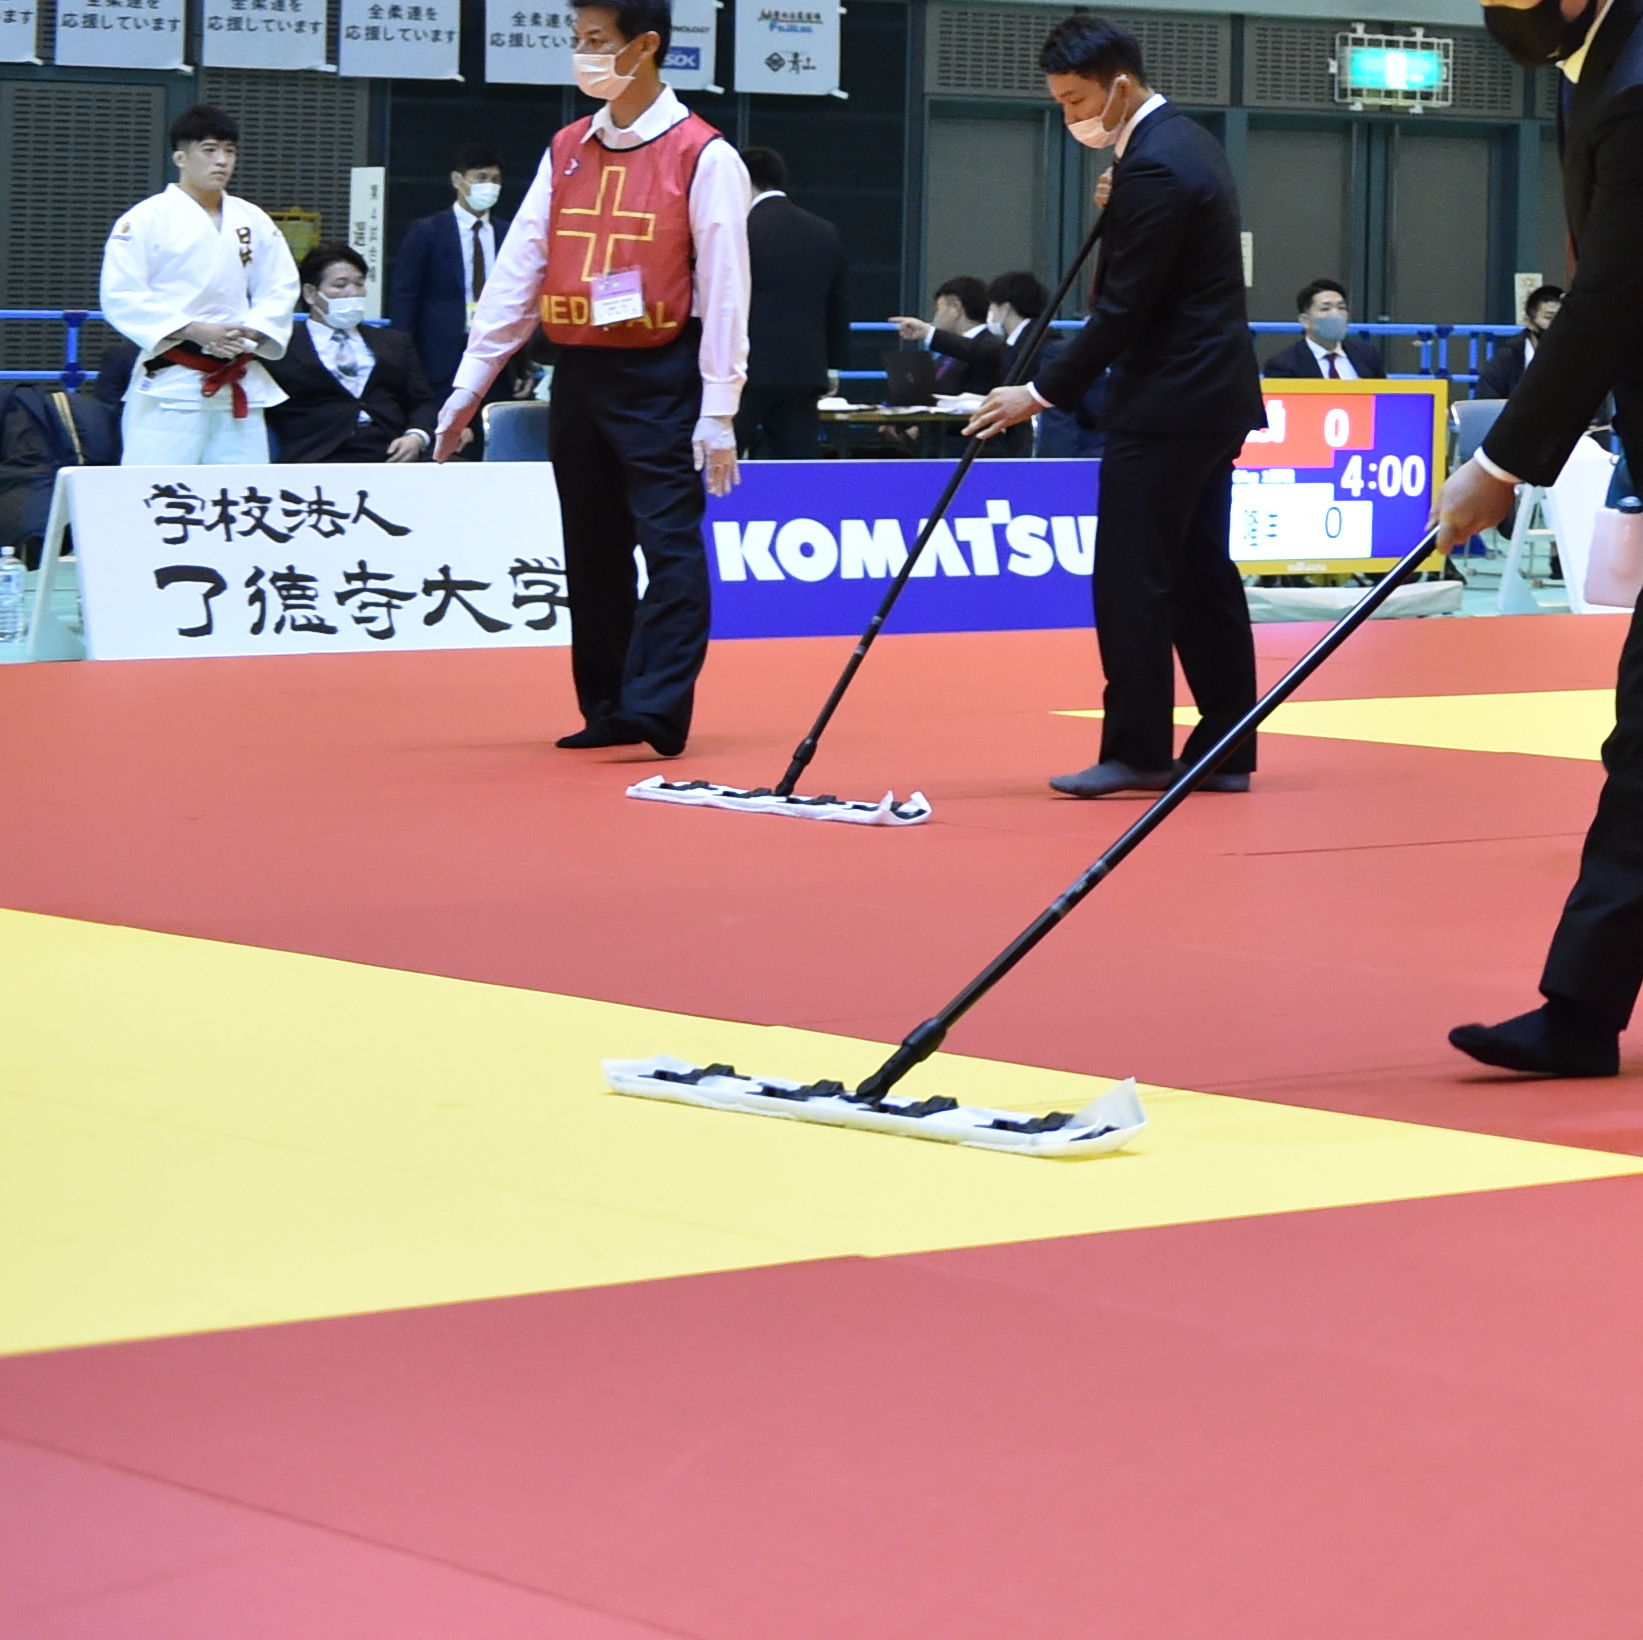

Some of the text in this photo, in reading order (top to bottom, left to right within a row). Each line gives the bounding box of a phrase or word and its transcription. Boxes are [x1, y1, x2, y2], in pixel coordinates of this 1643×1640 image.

[2, 10, 34, 25] ます
[60, 12, 182, 33] 応援しています
[206, 15, 324, 36] 応援しています
[344, 24, 459, 45] 応援しています
[1323, 408, 1350, 448] 0
[1340, 454, 1426, 497] 4:00
[143, 482, 413, 545] 学校法人
[1325, 506, 1343, 539] 0
[712, 499, 1099, 583] KOMATSU
